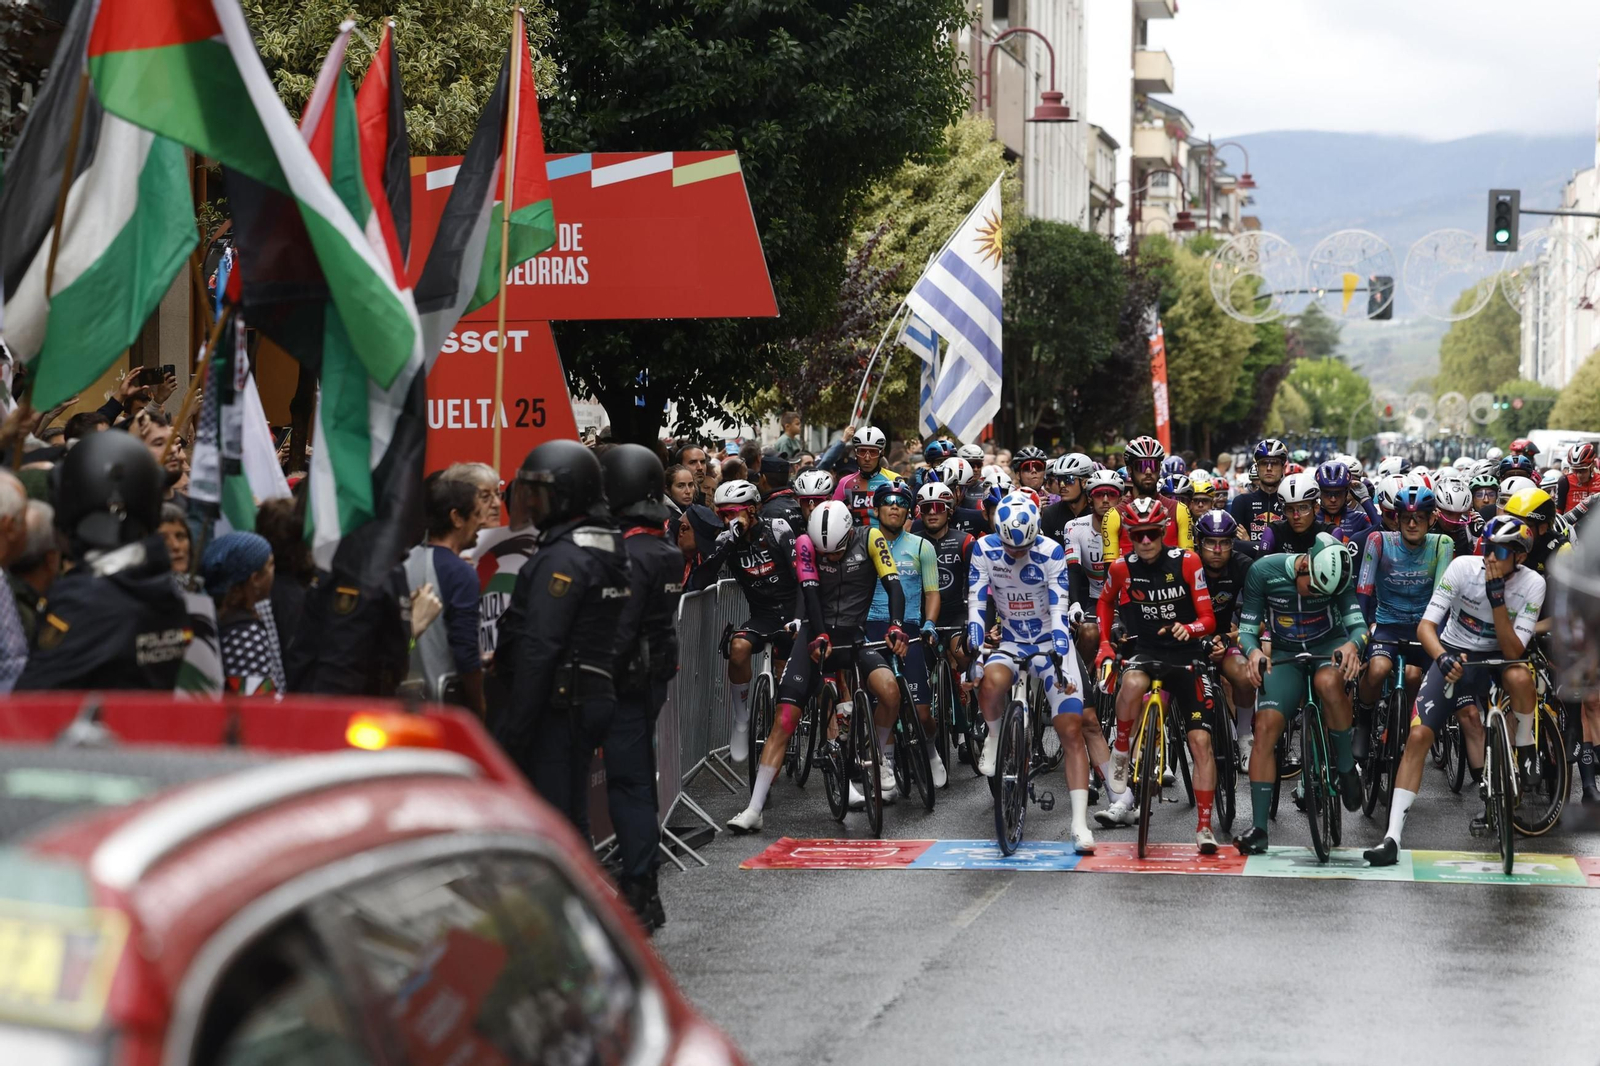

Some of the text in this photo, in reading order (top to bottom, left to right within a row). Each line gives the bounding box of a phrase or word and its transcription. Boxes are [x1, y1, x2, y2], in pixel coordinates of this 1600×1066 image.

[559, 223, 583, 251] DE
[515, 398, 546, 428] 25
[740, 549, 772, 569] UAE
[1007, 593, 1034, 602] UAE
[1148, 585, 1186, 601] VISMA
